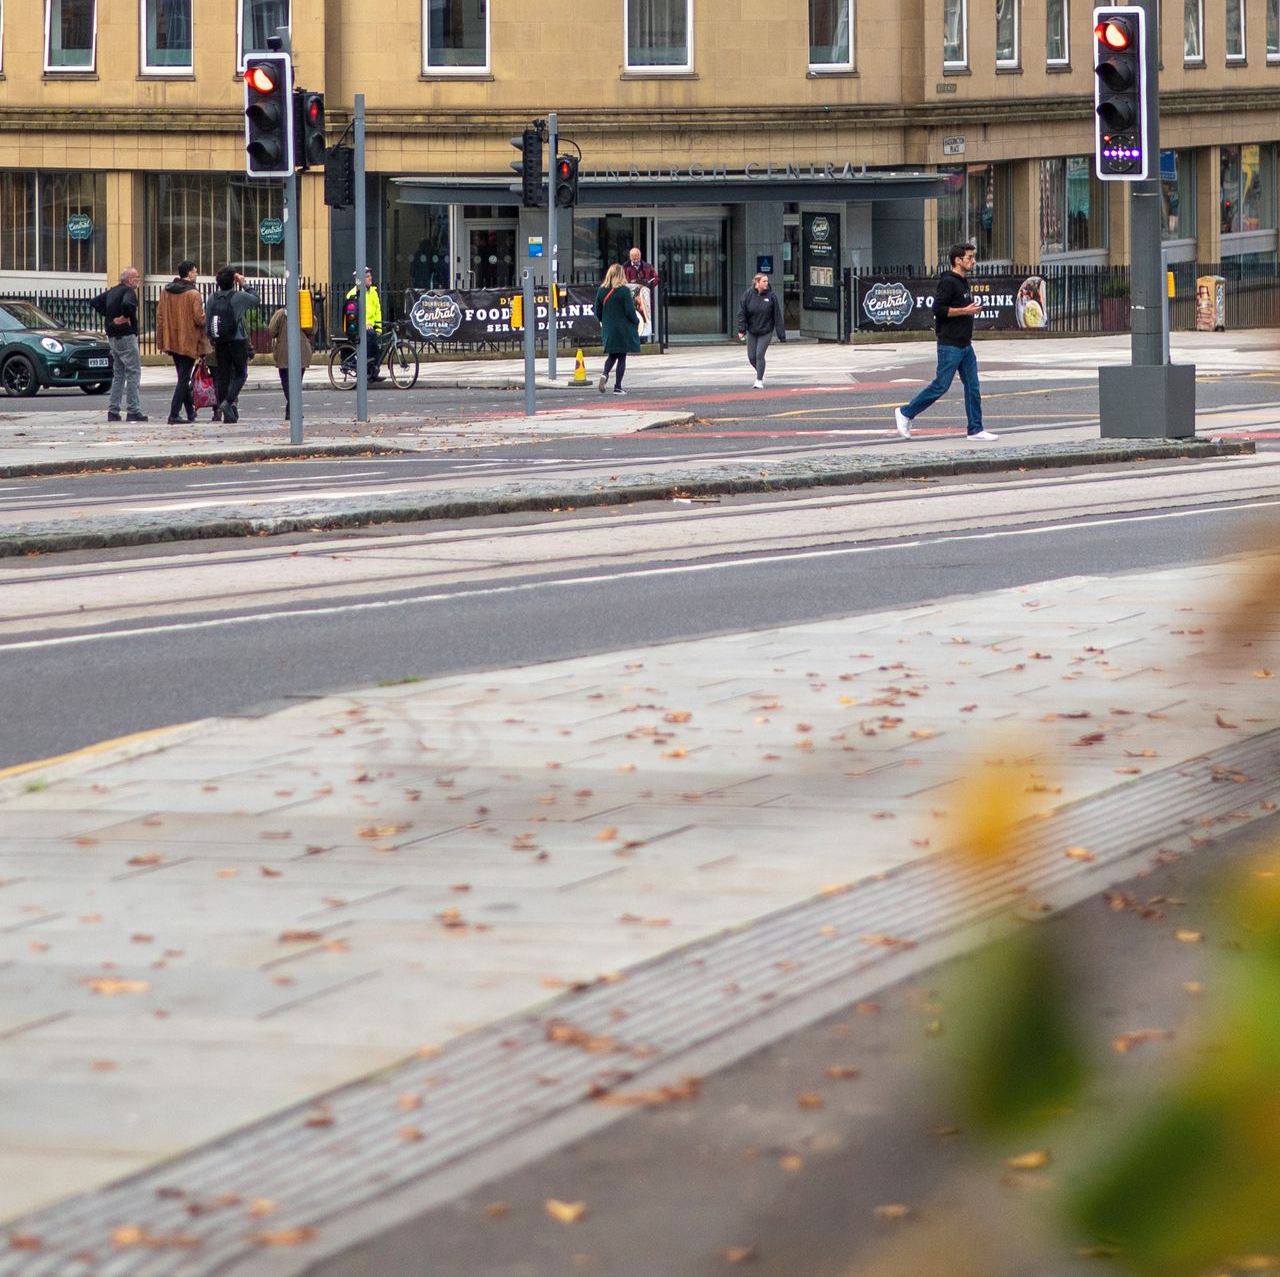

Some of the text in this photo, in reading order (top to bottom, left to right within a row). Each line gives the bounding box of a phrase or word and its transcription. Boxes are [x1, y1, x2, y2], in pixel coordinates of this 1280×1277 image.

[578, 161, 873, 182] INBURGH CENTRAL
[867, 292, 908, 311] Central
[973, 295, 1014, 307] DRINK
[414, 304, 456, 322] Central
[465, 304, 595, 321] FOOD DINK
